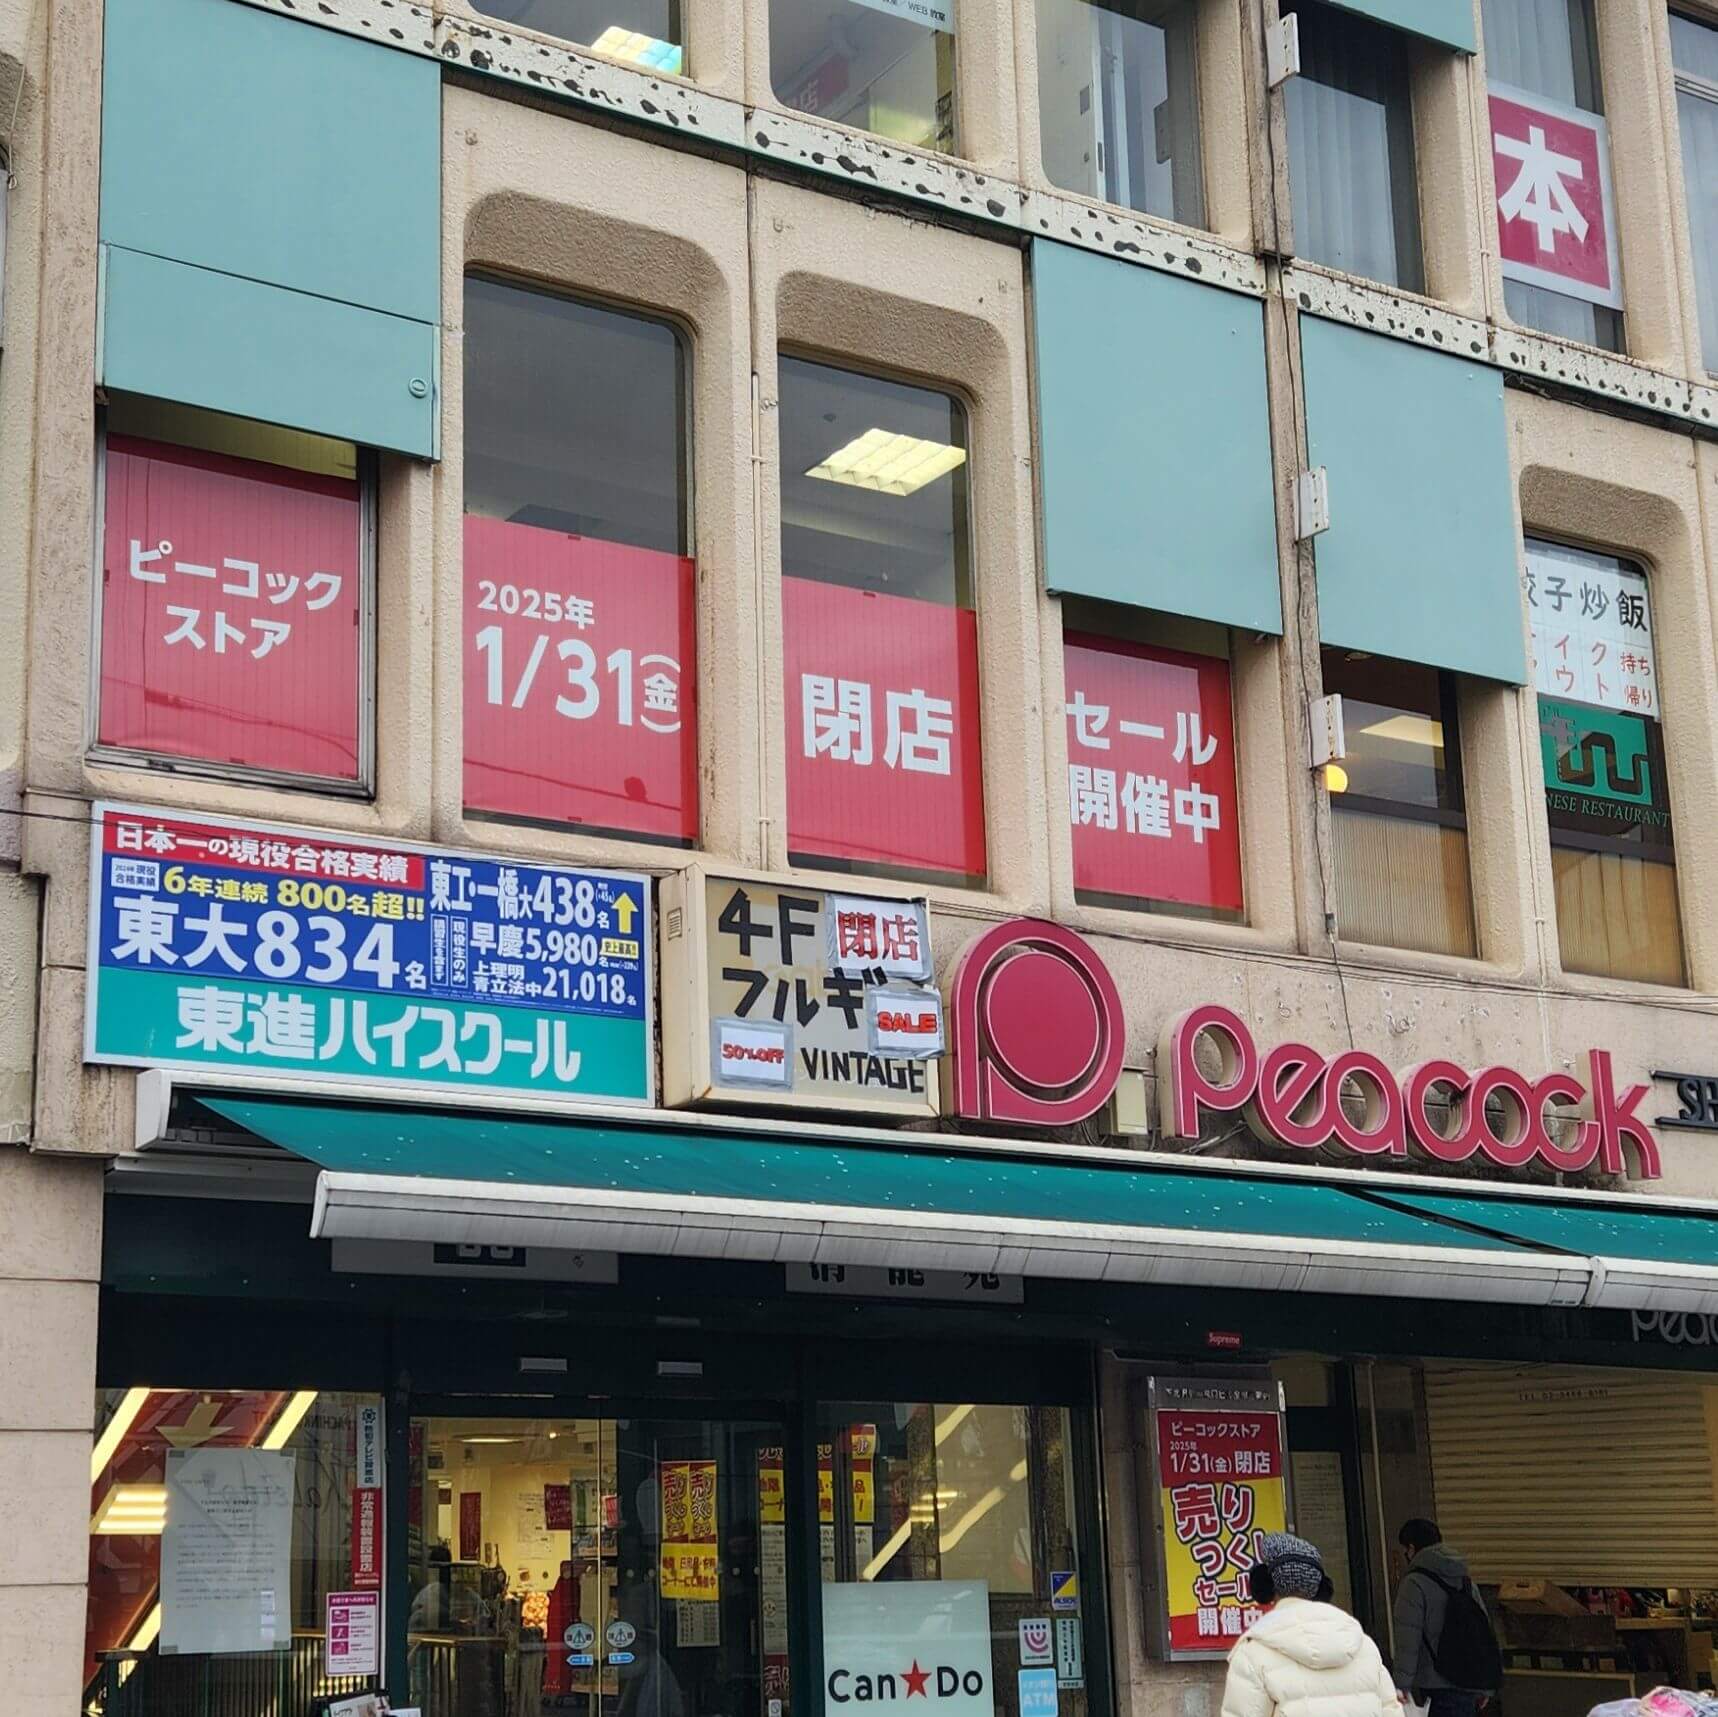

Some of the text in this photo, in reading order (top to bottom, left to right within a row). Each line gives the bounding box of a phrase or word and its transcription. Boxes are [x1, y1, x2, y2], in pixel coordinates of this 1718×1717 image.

[1493, 126, 1590, 253] 本
[128, 539, 342, 611] ピーコック
[477, 579, 595, 630] 2025年
[163, 604, 291, 659] ストア
[475, 625, 682, 735] 1/31(金)
[1620, 652, 1651, 677] 持ち
[801, 673, 954, 775] 閉店
[1065, 690, 1218, 766] セール
[1068, 763, 1221, 844] 開催中
[1582, 798, 1670, 827] RESTAURANT
[116, 821, 409, 884] 日本一の現役合格実績
[163, 865, 269, 905] 6年連続
[110, 894, 427, 991] 東大834名
[452, 921, 466, 983] 現役生のみ
[718, 887, 820, 966] 4F
[836, 911, 920, 961] 閉店
[472, 960, 525, 980] 上理明
[722, 965, 888, 1030] フルギ
[876, 1010, 938, 1034] SALE
[175, 985, 583, 1083] 東進ハイスクール
[721, 1042, 785, 1066] 50%OFF
[800, 1047, 925, 1094] VINTAGE
[1208, 1333, 1241, 1346] Supreme
[1169, 1441, 1197, 1452] 2025年
[1170, 1420, 1261, 1440] ピーコックストア
[1234, 1451, 1271, 1475] 閉店
[1171, 1482, 1256, 1543] 売り
[1197, 1606, 1264, 1637] 開催中
[827, 1668, 897, 1703] Can
[936, 1665, 984, 1698] Do
